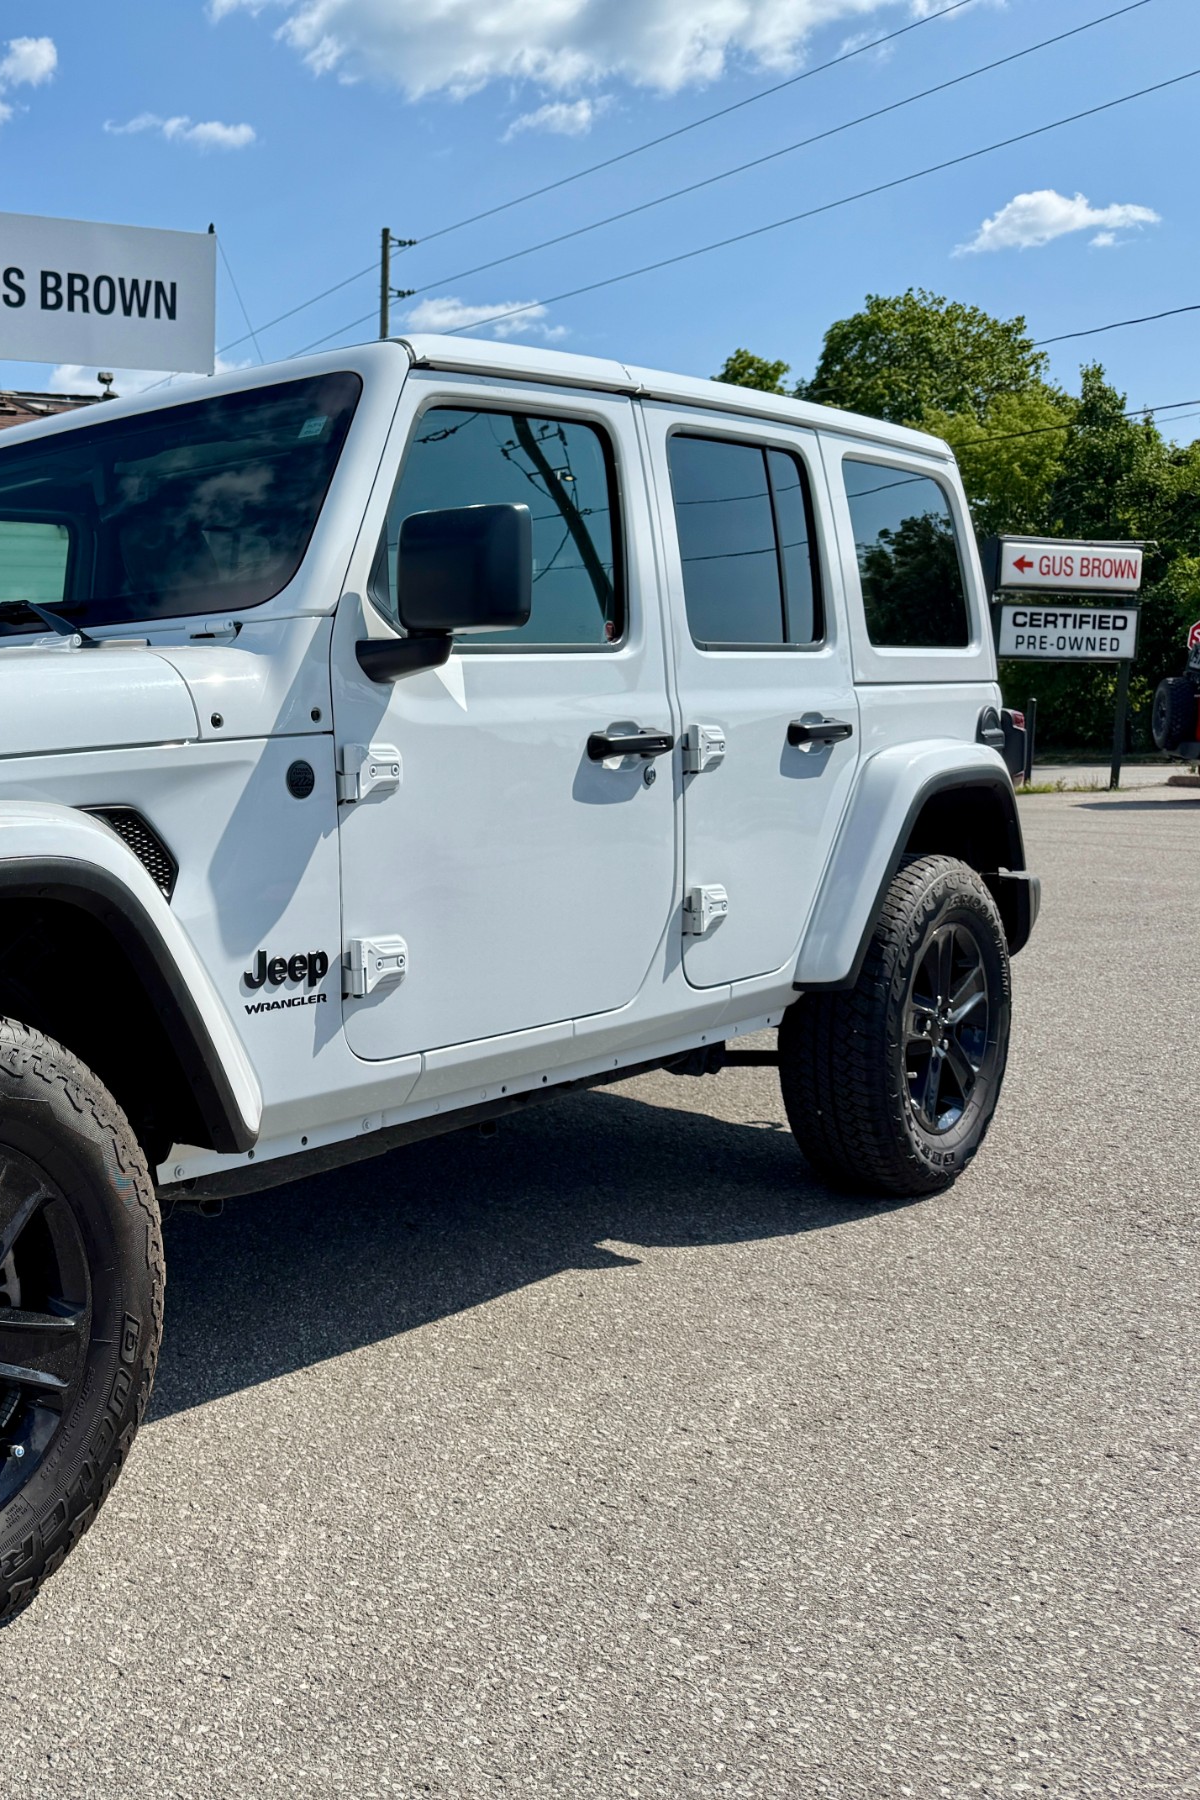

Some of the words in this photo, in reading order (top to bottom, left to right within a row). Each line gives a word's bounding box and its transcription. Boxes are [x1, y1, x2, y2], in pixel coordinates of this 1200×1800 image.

[40, 270, 177, 321] BROWN
[1038, 555, 1073, 577] GUS
[1080, 558, 1137, 579] BROWN
[1012, 611, 1128, 631] CERTIFIED
[1015, 635, 1120, 651] PRE-OWNED
[243, 949, 329, 989] Jeep
[244, 993, 327, 1015] WRANGLER
[0, 1311, 141, 1581] DUELER
